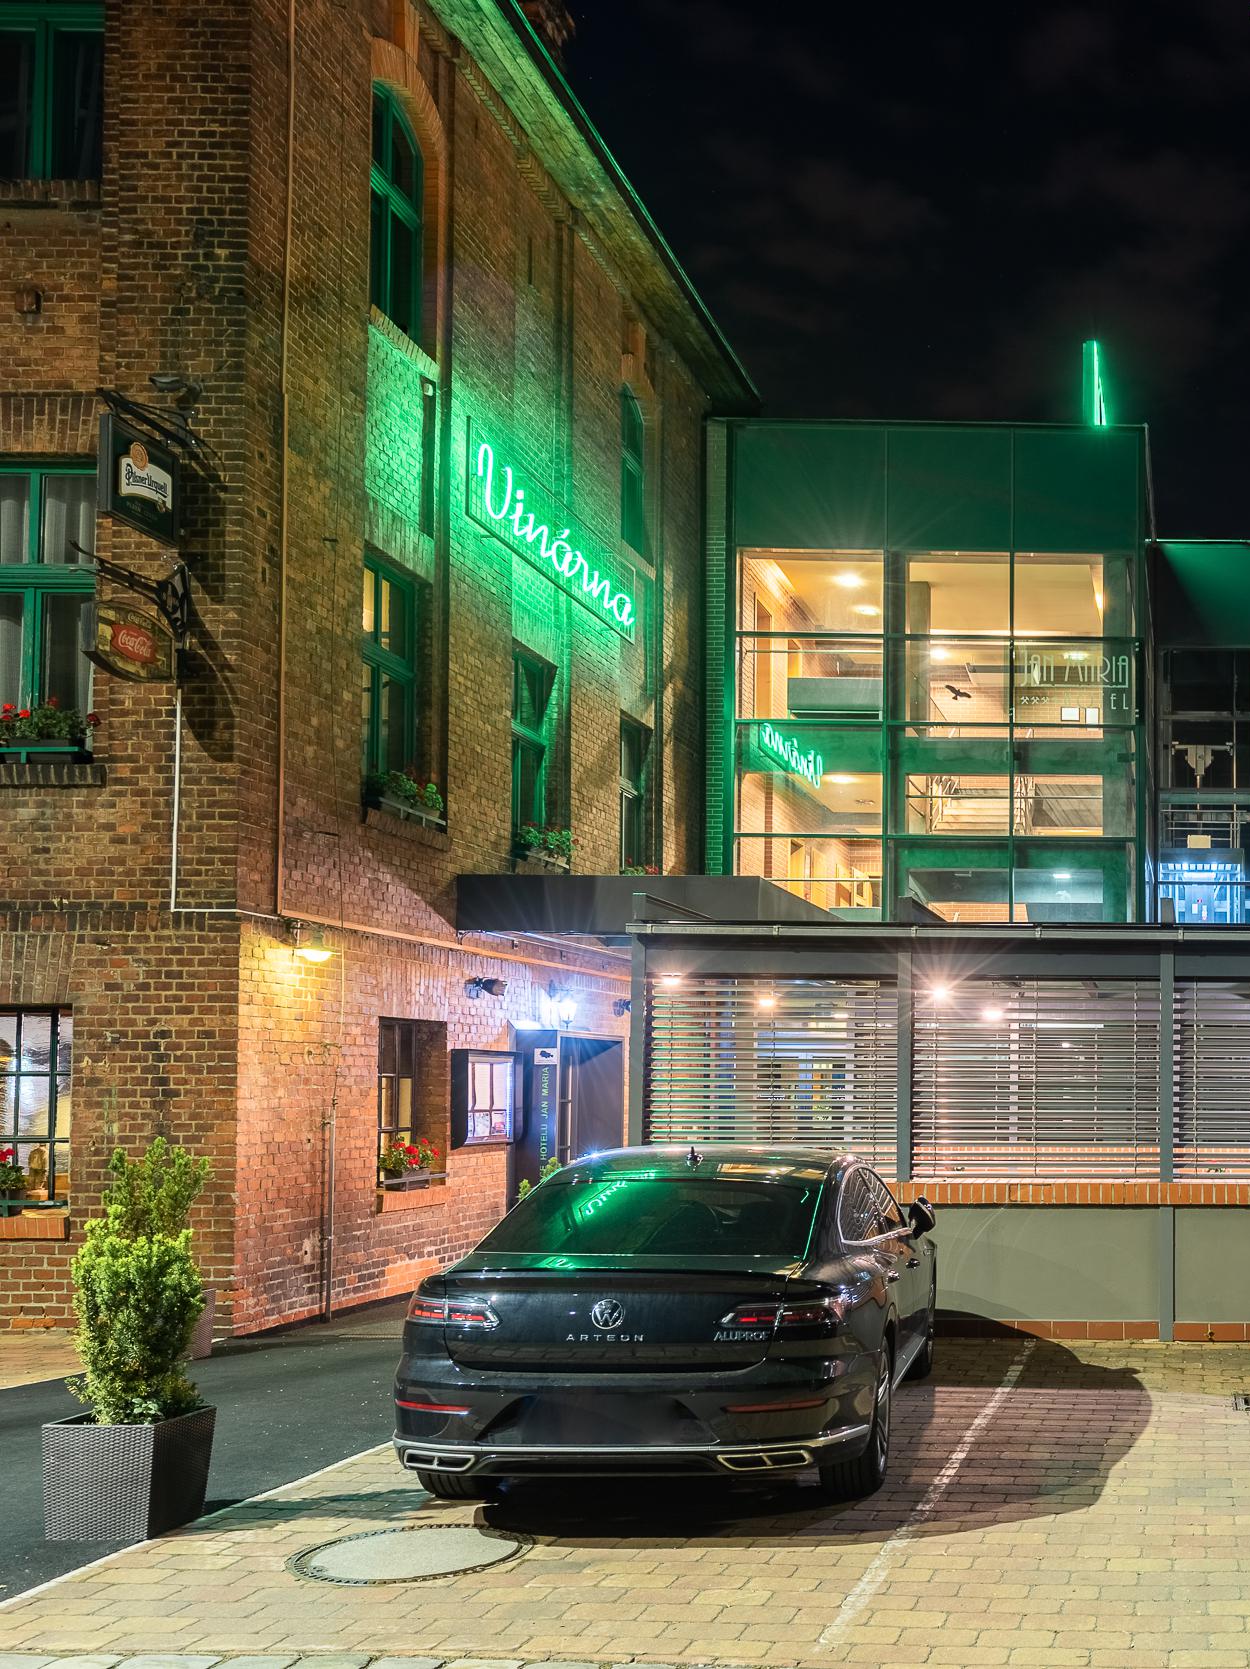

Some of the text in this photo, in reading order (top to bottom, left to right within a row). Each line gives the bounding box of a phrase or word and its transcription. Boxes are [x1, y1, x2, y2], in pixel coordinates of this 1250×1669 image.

[125, 463, 168, 495] Pilsner Urquell
[477, 443, 635, 626] Vinárna
[1020, 645, 1055, 687] JAN
[541, 1067, 549, 1096] MARIA
[540, 1100, 548, 1119] JAN
[540, 1123, 548, 1160] HOTELU
[566, 1333, 644, 1342] ARTEON
